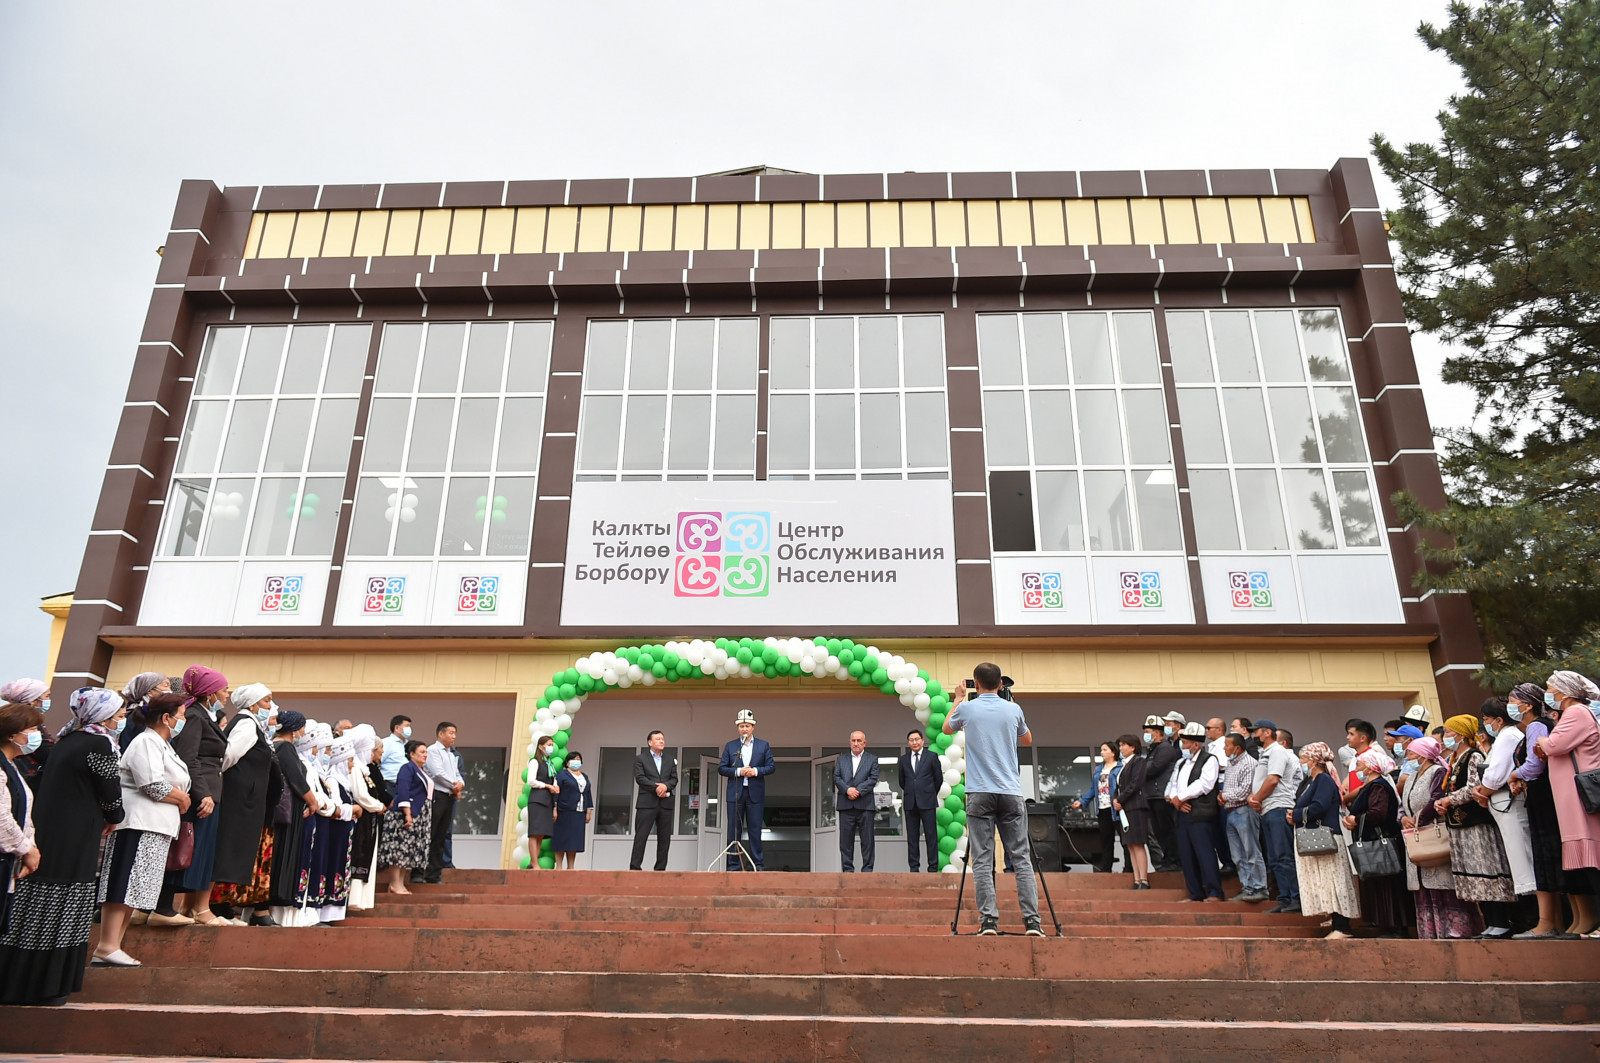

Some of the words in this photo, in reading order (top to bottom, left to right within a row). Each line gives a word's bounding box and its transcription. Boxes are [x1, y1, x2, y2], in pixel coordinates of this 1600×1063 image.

[592, 520, 671, 536] Калкты
[778, 521, 844, 541] Центр
[592, 540, 670, 559] Тейлөө
[777, 540, 945, 564] Обслуживания
[575, 563, 670, 585] Борбору
[777, 567, 897, 583] Населения
